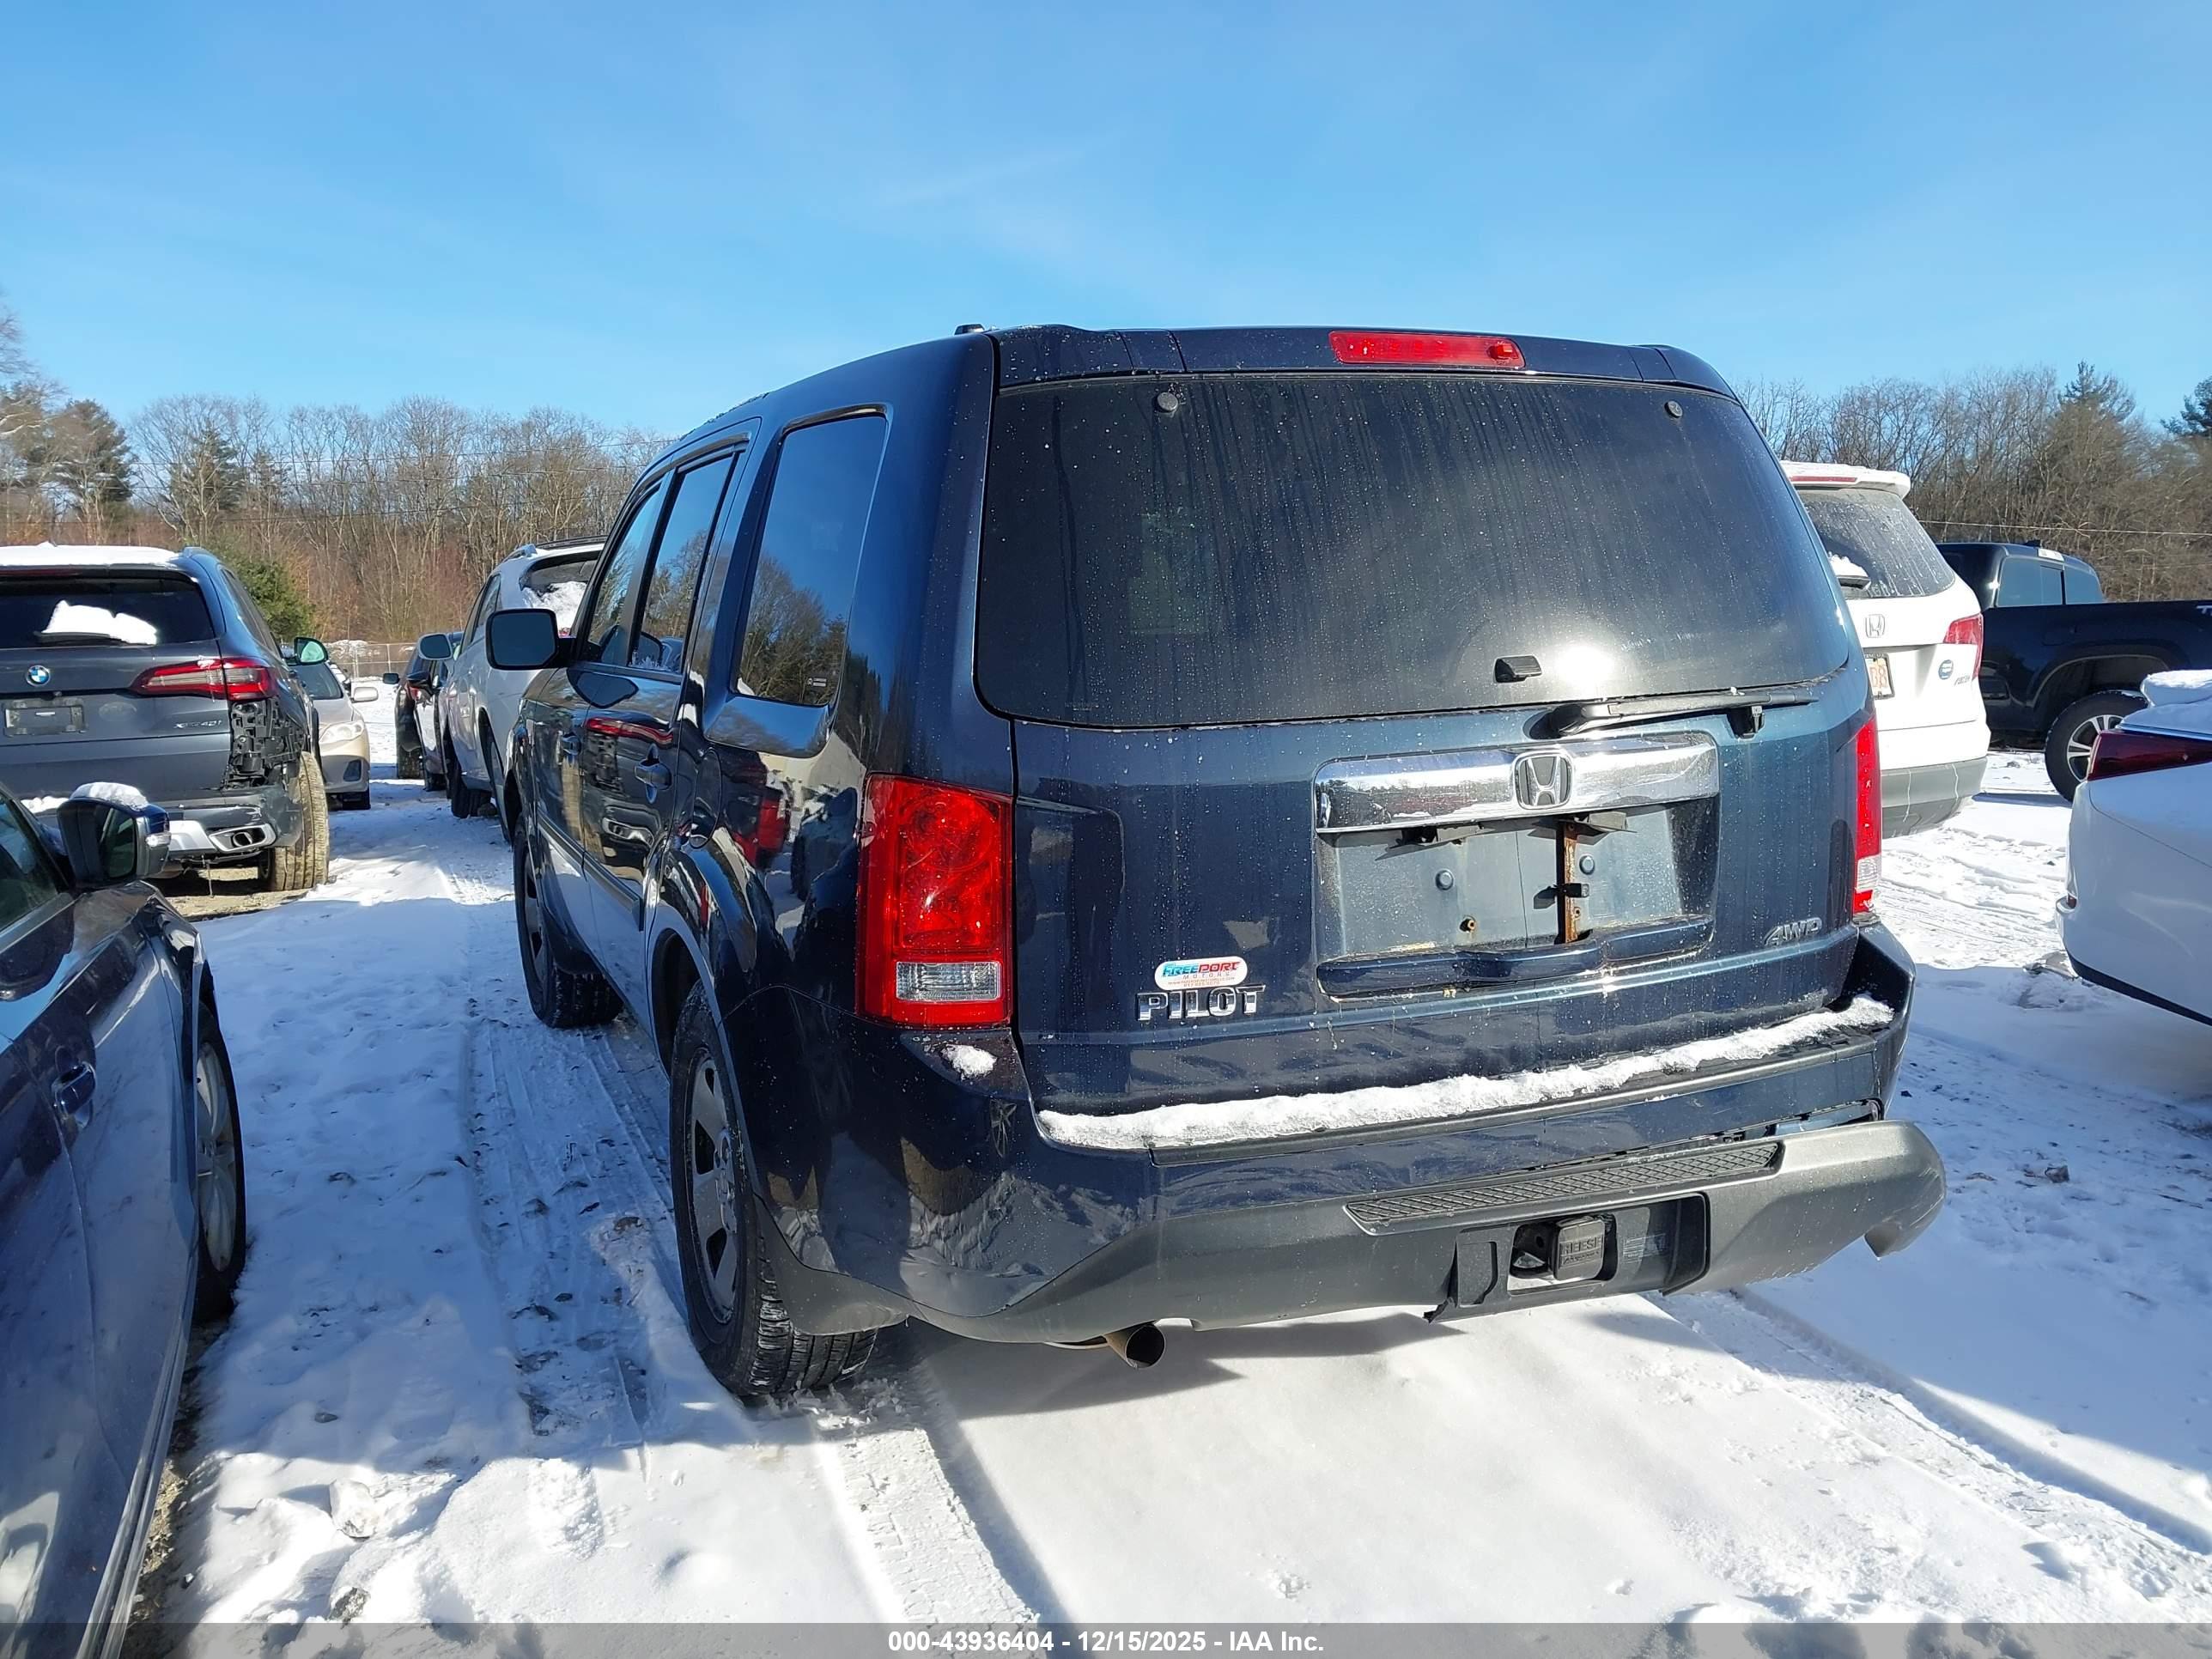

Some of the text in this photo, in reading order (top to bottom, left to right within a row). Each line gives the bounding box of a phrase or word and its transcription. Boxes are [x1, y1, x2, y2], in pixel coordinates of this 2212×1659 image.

[1765, 917, 1822, 945] 4WD
[1163, 961, 1241, 976] FREEPORT
[1138, 985, 1266, 1021] PILOT
